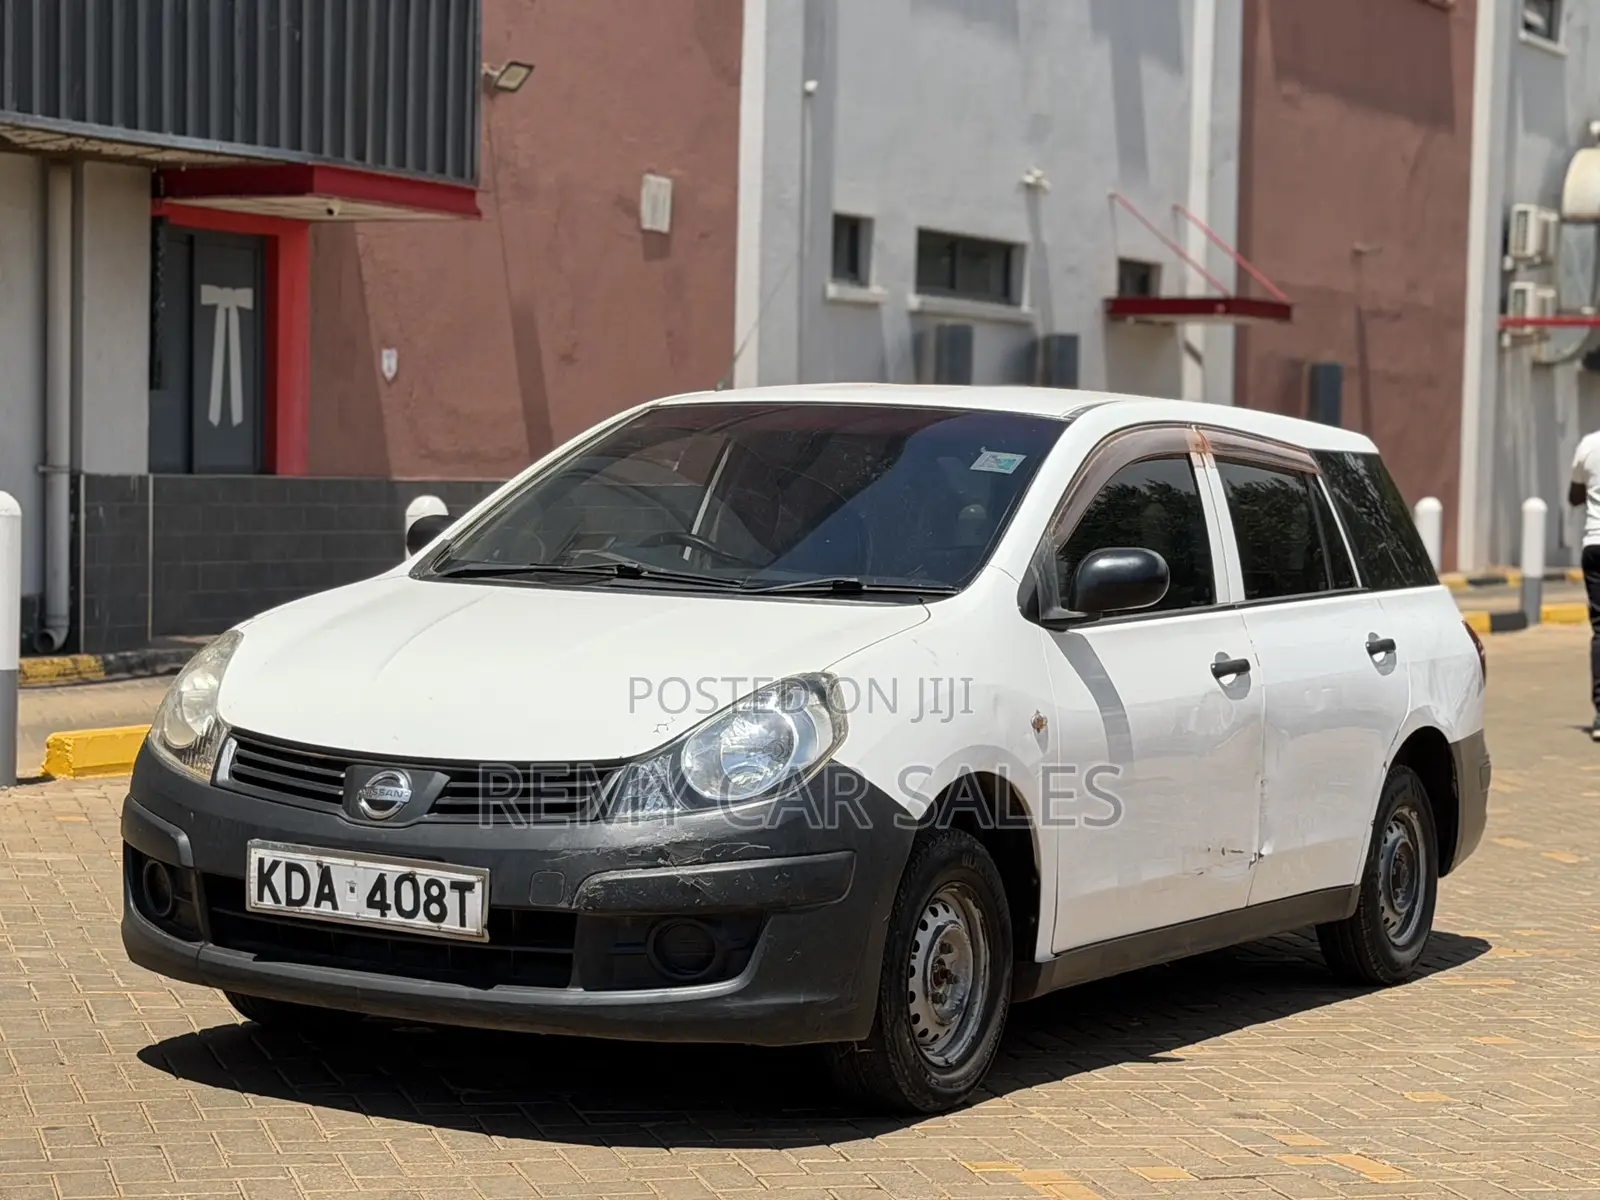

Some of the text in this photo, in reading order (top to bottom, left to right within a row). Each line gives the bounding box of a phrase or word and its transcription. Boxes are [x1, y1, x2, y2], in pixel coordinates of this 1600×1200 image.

[361, 787, 404, 798] NISSAN
[257, 857, 476, 928] KDA 408T
